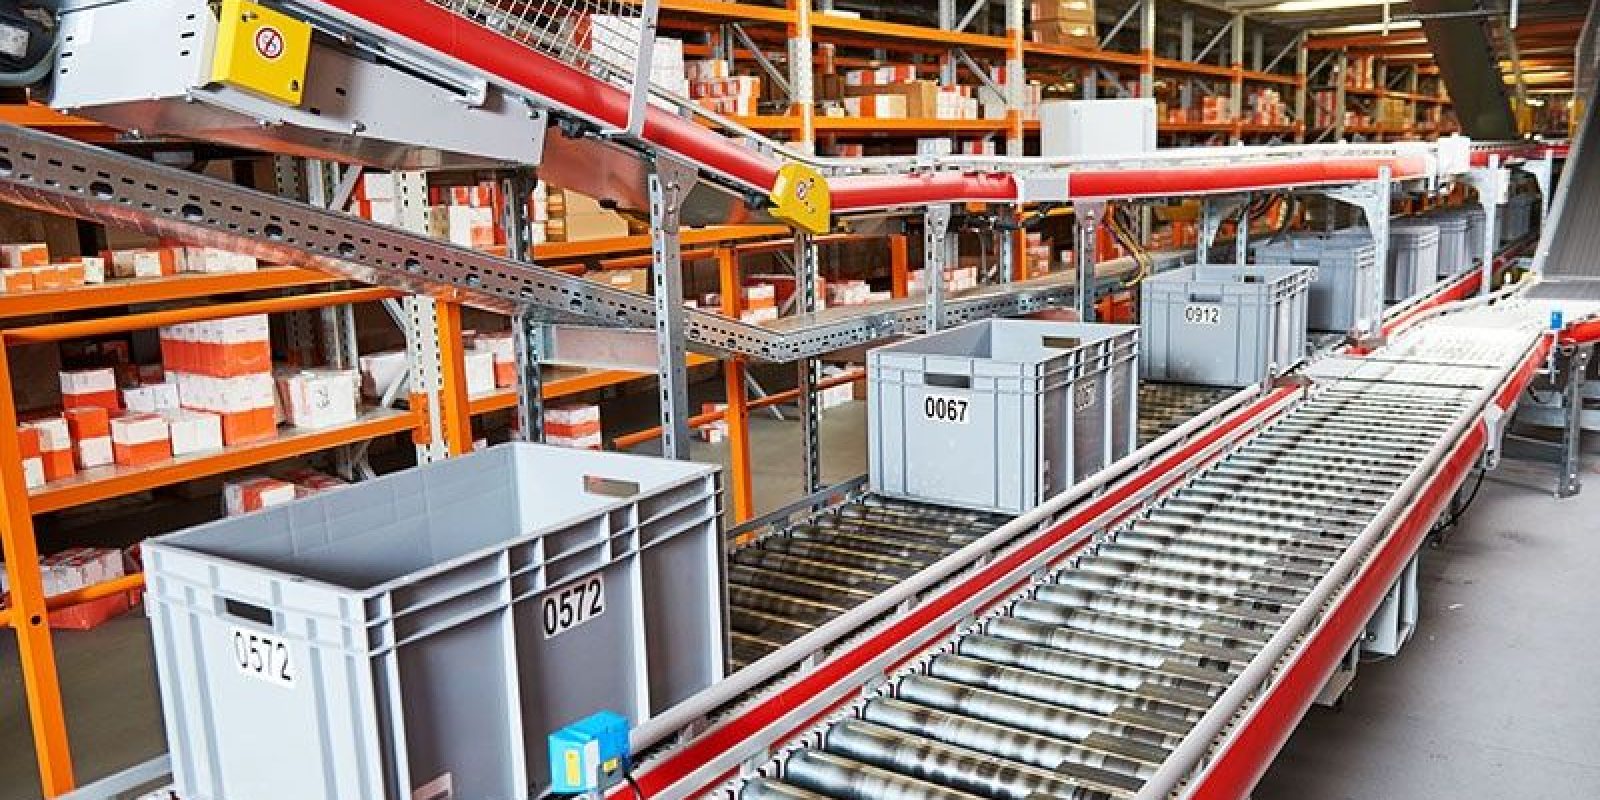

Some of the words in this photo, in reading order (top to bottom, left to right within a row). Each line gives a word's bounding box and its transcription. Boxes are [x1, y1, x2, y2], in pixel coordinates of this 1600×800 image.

[1185, 306, 1219, 323] 0912
[925, 396, 968, 422] 0067
[543, 578, 602, 634] 0572
[233, 630, 292, 682] 0572
